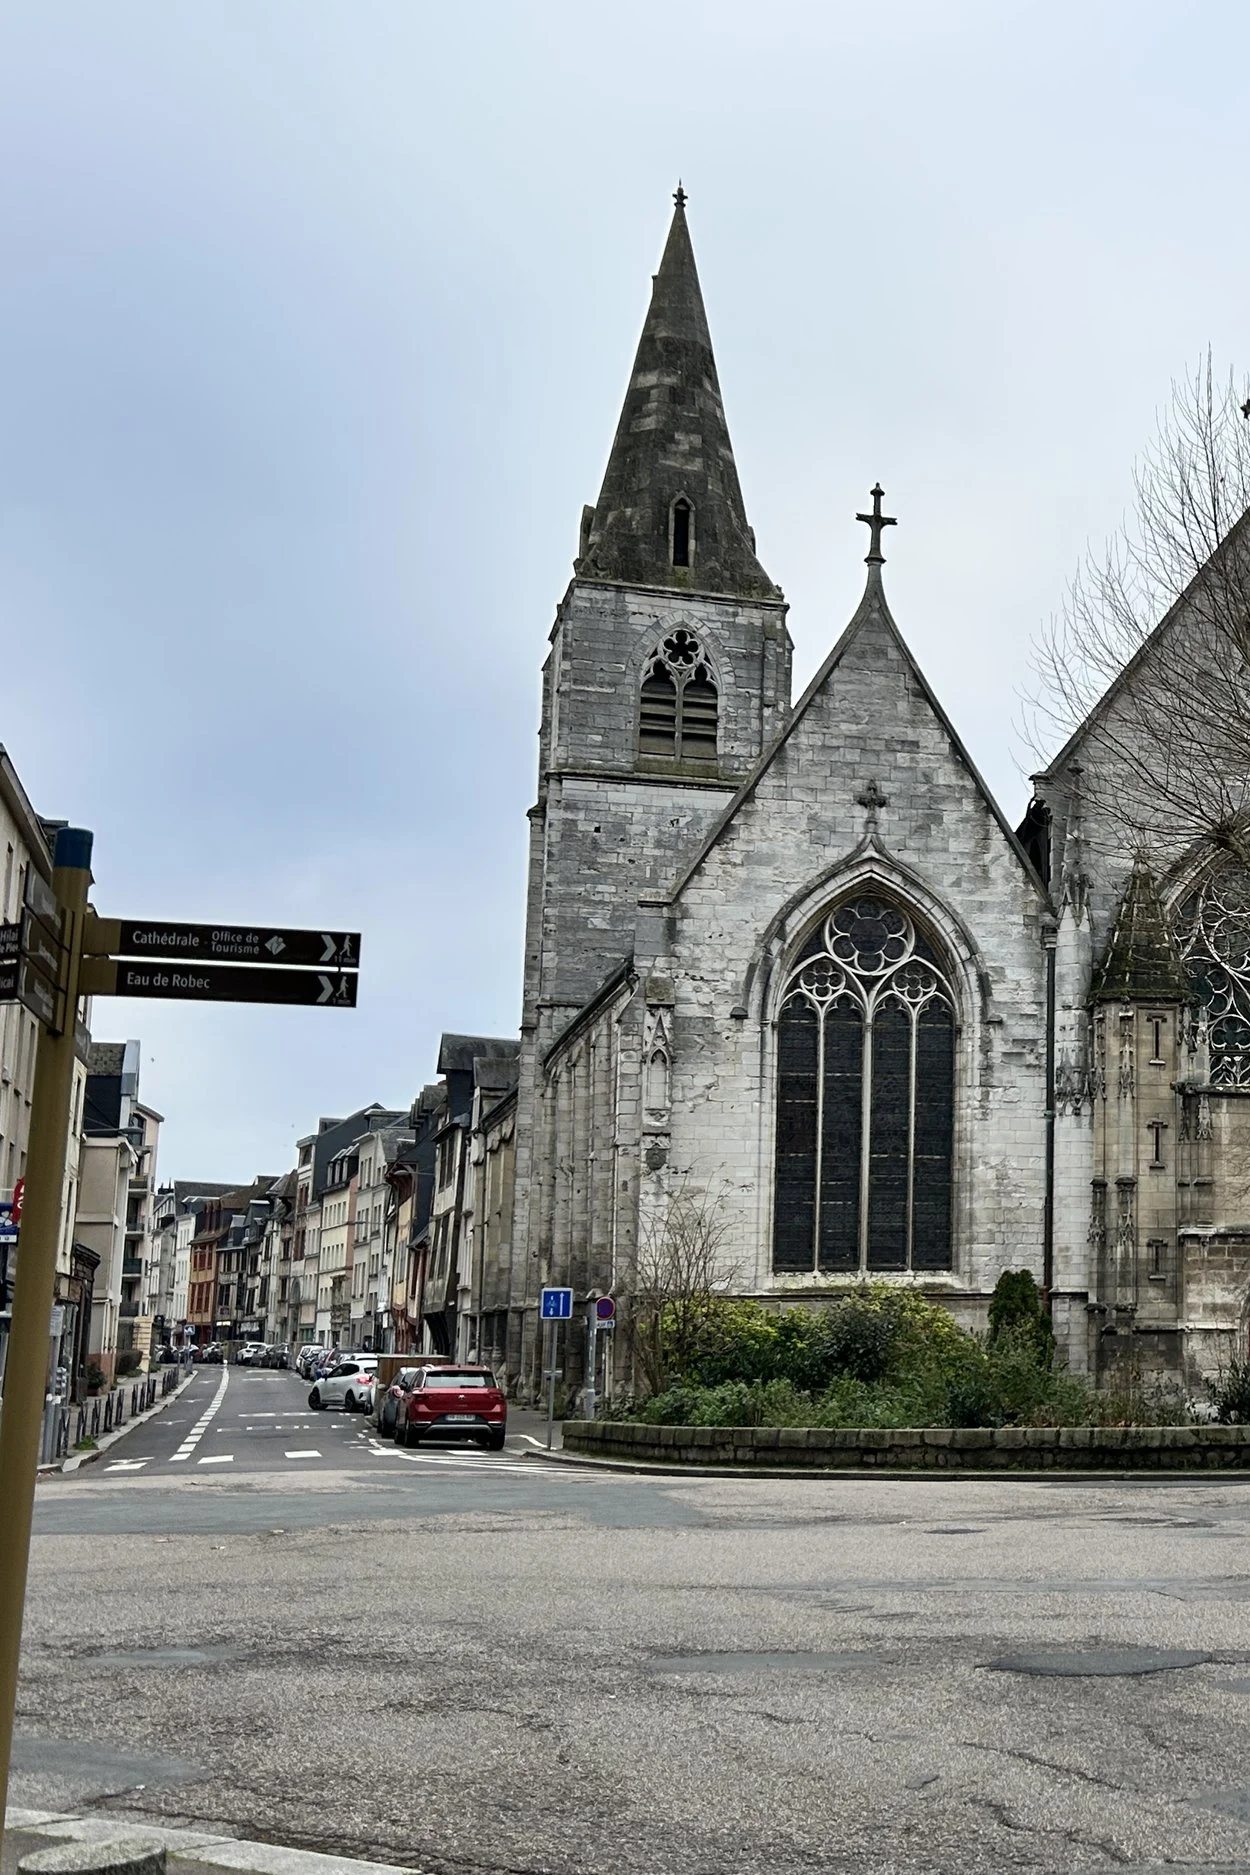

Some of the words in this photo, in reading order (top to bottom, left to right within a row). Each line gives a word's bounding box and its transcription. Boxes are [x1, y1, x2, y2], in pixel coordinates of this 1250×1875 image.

[132, 930, 200, 947] Cathédrale
[211, 930, 243, 942] Office
[245, 932, 259, 943] de
[211, 941, 260, 954] Tourisme
[127, 971, 150, 986] Eau
[153, 972, 169, 987] de
[172, 973, 211, 989] Robec
